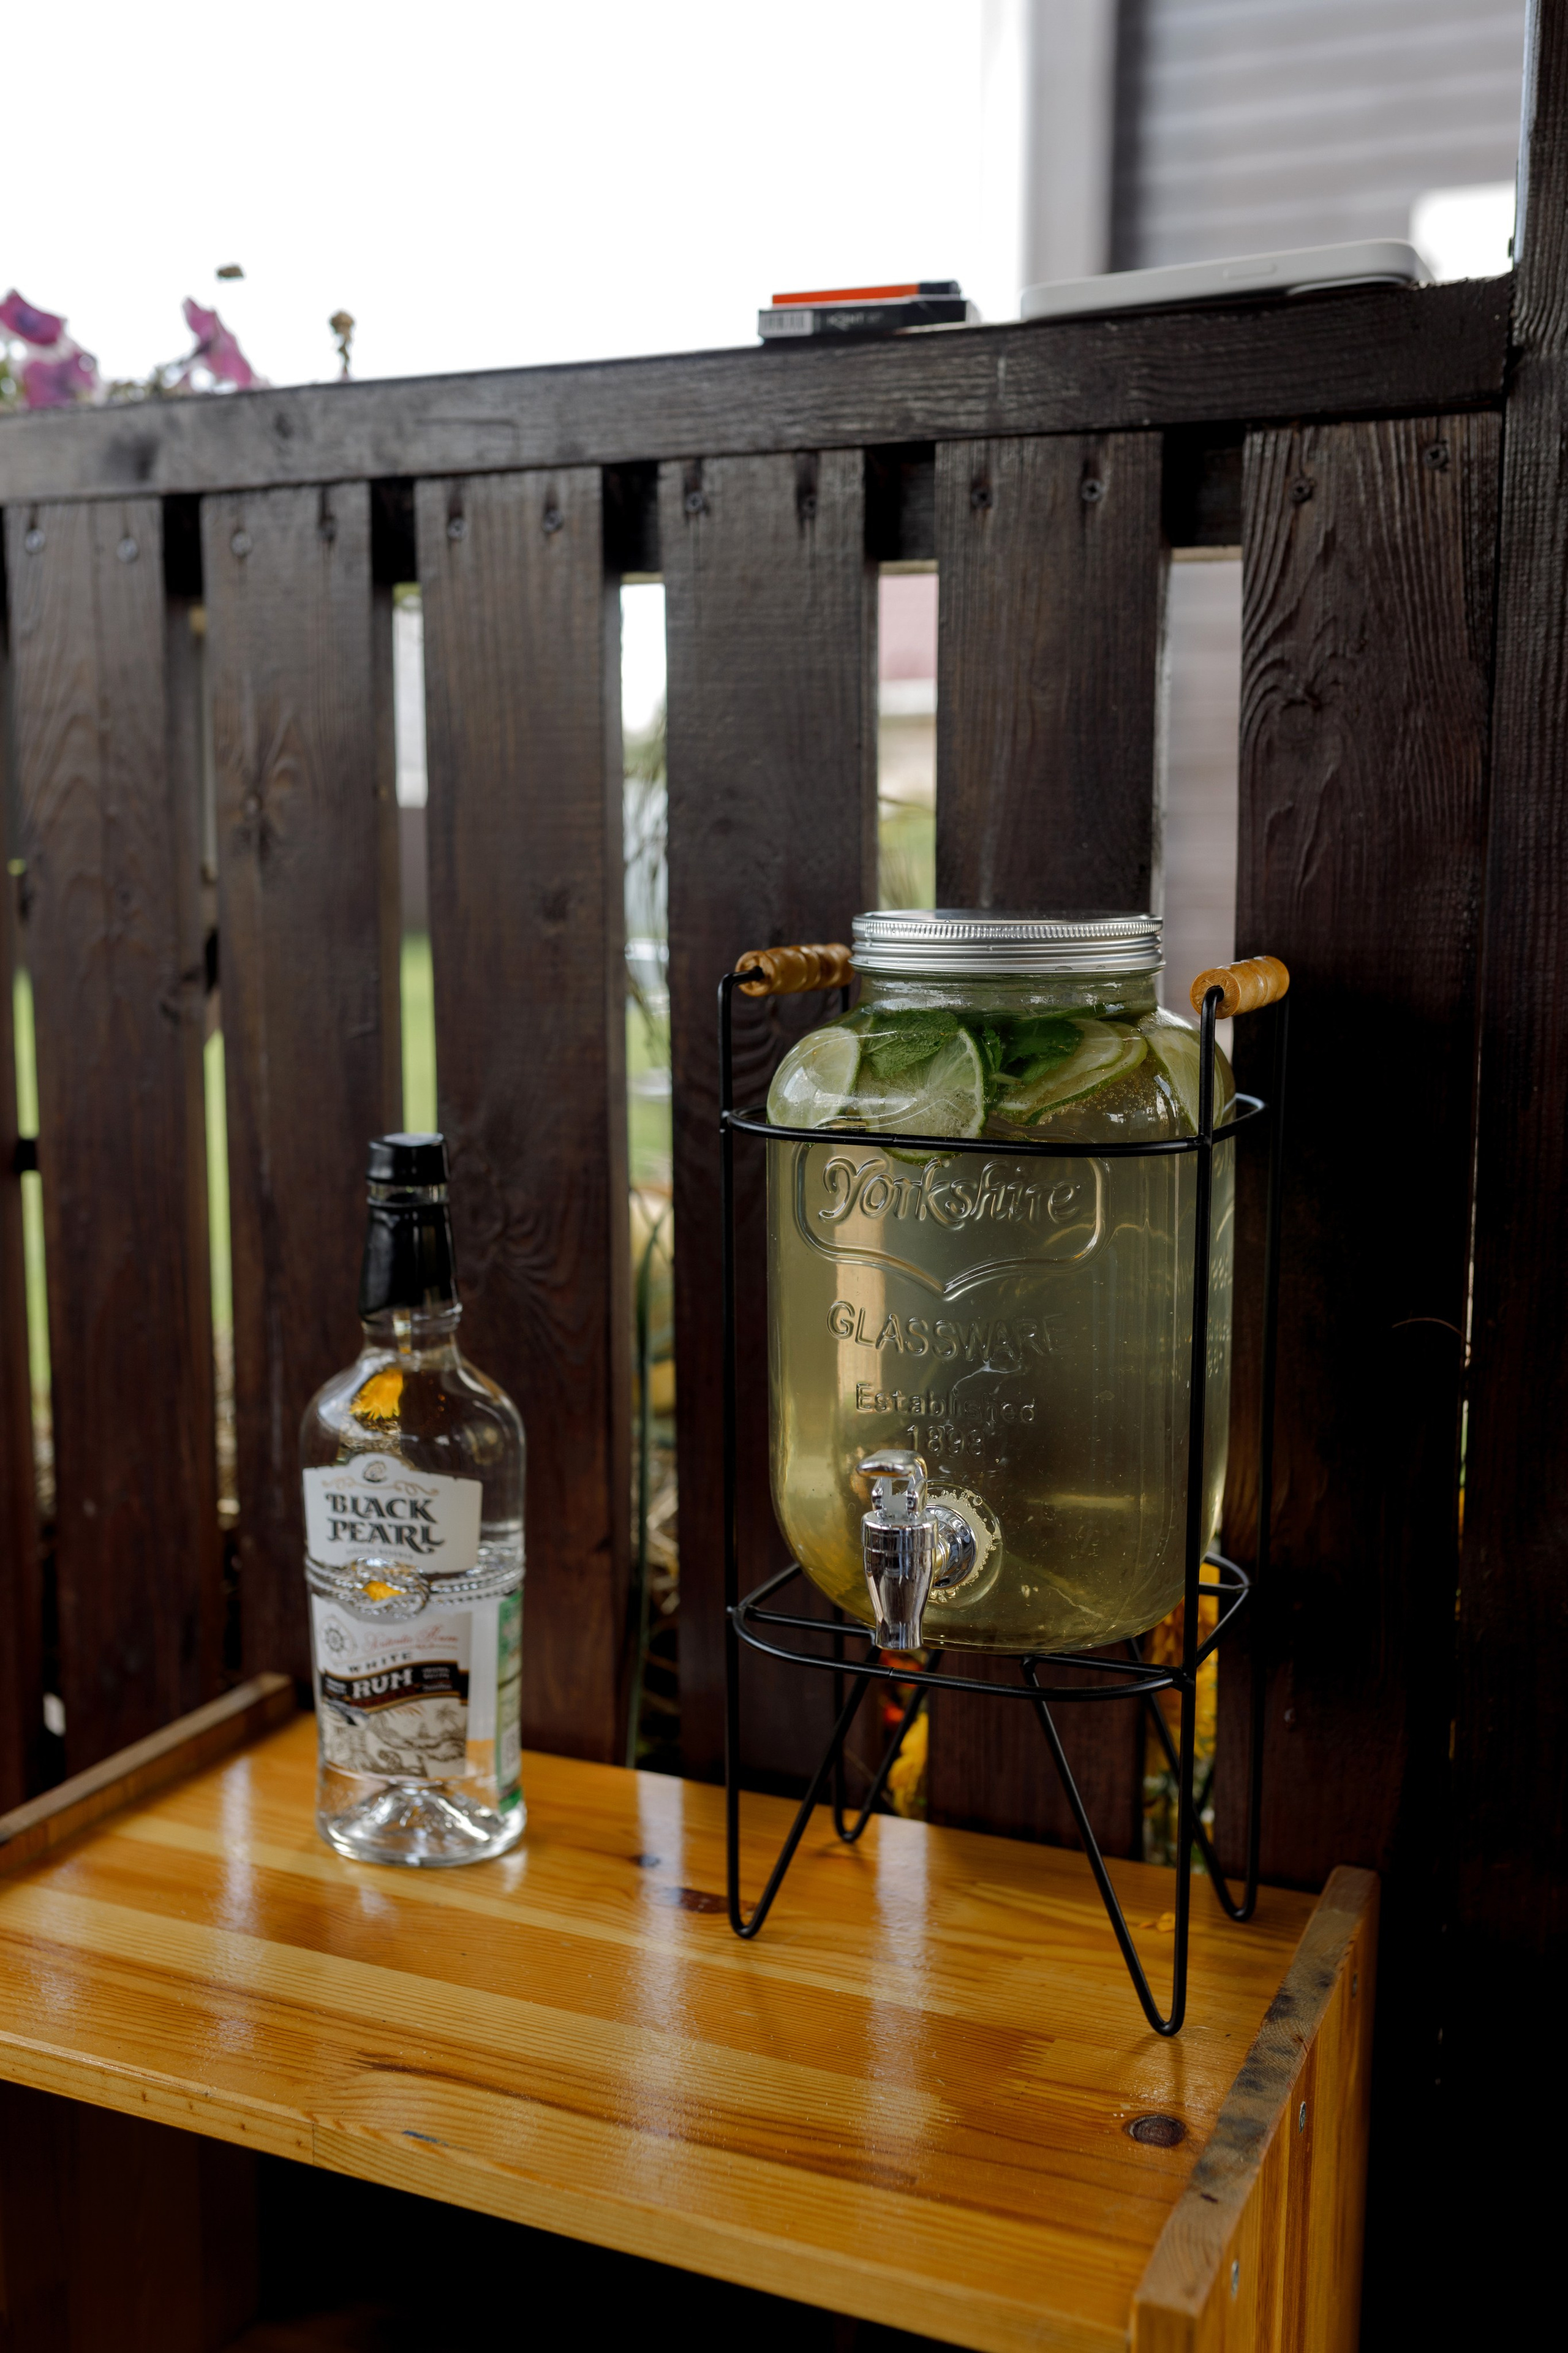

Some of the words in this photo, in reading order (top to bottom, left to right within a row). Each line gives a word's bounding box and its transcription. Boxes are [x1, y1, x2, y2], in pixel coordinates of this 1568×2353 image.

[818, 1157, 1081, 1230] Yorkshire
[826, 1301, 1067, 1361] GLASSWARE
[856, 1383, 1036, 1424] Established
[326, 1493, 438, 1524] BLACK
[327, 1518, 445, 1555] PEARL
[348, 1652, 413, 1673] WHITE
[352, 1667, 415, 1699] RUM
